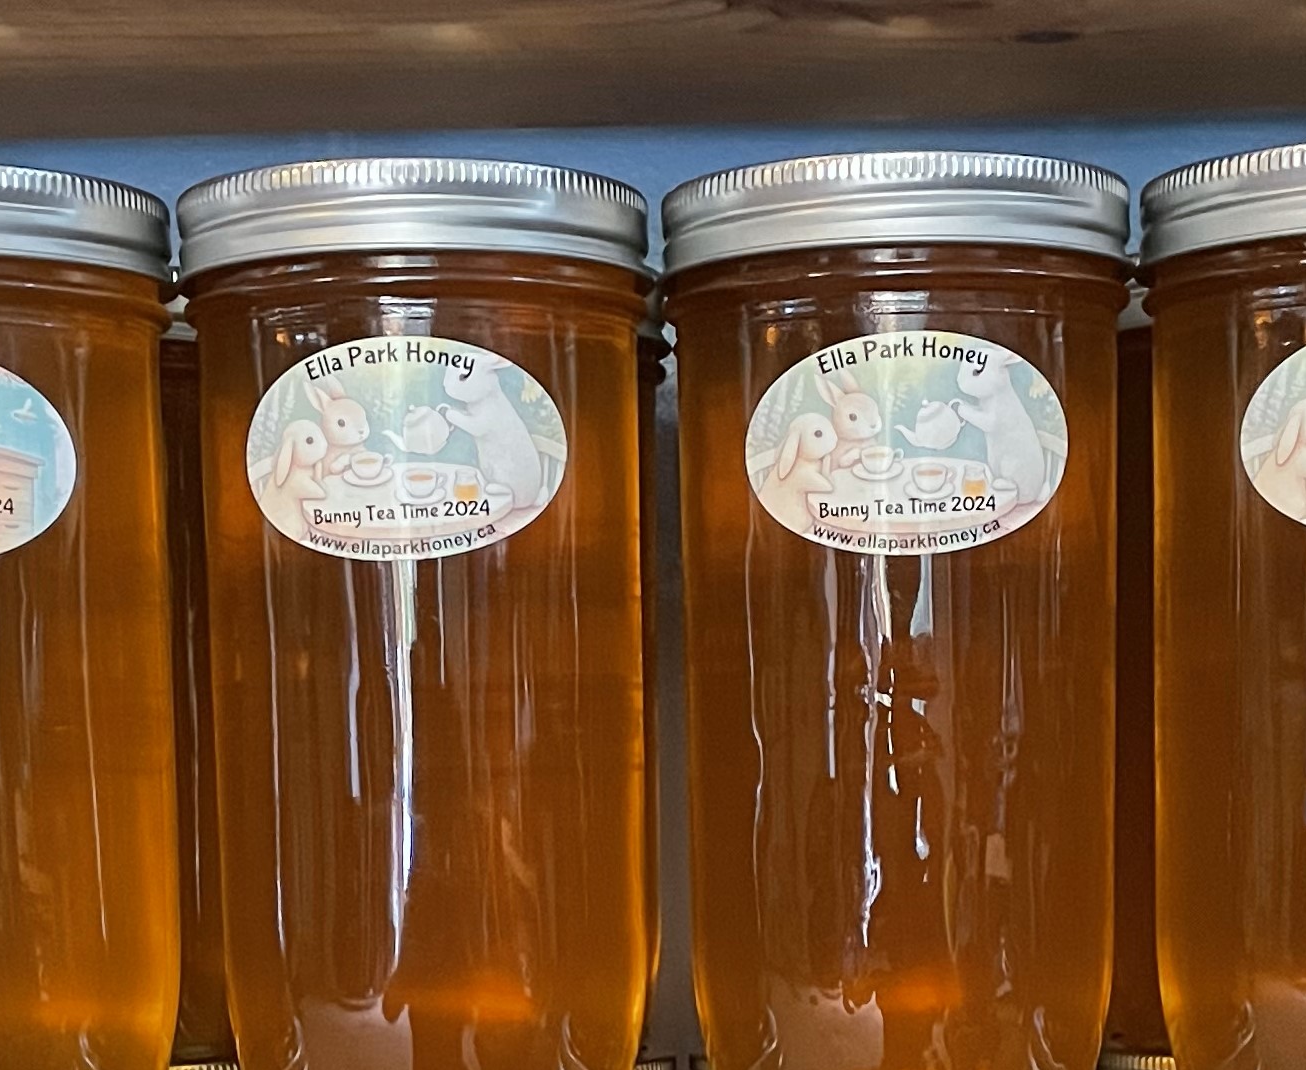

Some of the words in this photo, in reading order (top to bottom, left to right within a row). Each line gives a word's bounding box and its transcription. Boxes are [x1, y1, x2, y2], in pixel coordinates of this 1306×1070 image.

[305, 356, 343, 381] Ella
[348, 343, 398, 368] Park
[406, 342, 475, 379] Honey
[816, 349, 857, 375] Ella
[863, 338, 914, 362] Park
[922, 337, 988, 374] Honey
[314, 508, 361, 528] Bunny
[366, 505, 395, 521] Tea
[399, 504, 439, 519] Time
[443, 500, 490, 517] 2024
[819, 502, 869, 522] Bunny
[875, 500, 903, 515] Tea
[910, 498, 946, 514] Time
[951, 496, 996, 512] 2024
[309, 524, 496, 558] www.ellaparkhoney.ca
[814, 519, 1000, 552] www.ellaparkhoney.ca
